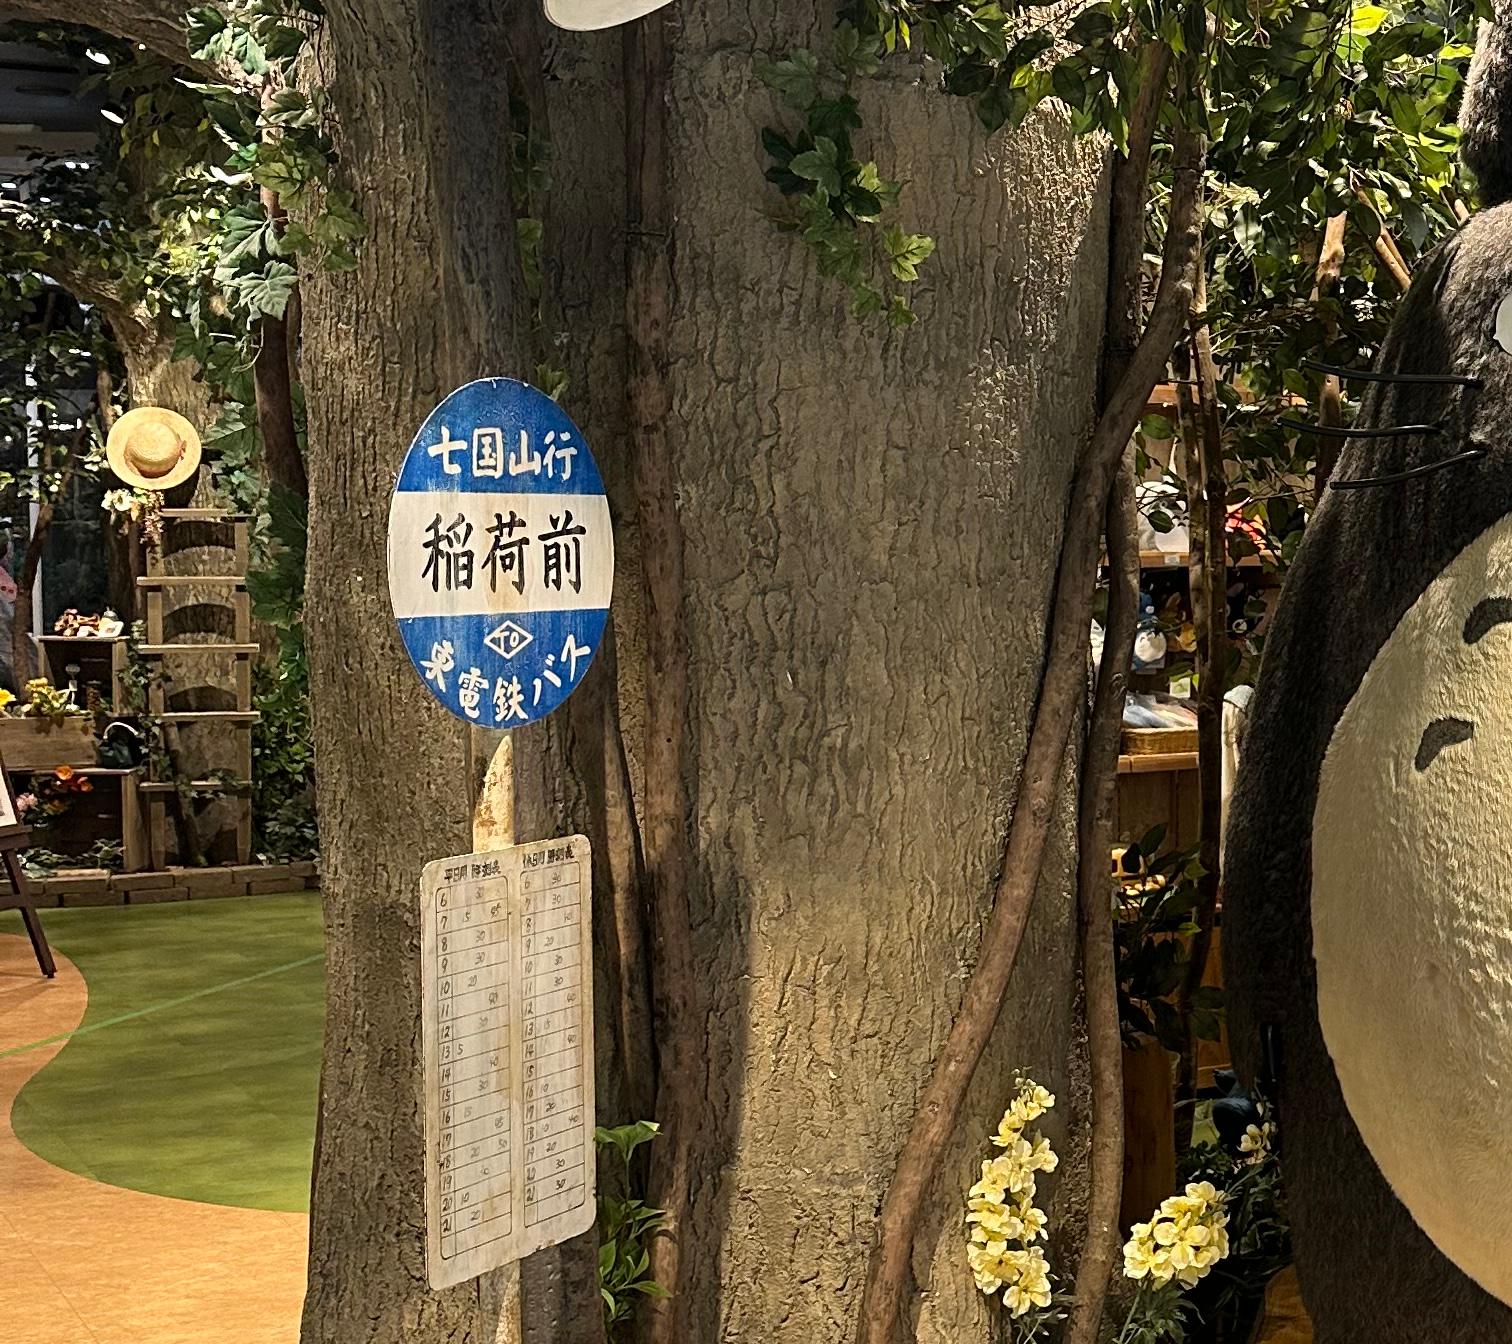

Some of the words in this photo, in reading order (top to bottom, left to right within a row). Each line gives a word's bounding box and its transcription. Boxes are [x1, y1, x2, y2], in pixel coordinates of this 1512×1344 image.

[427, 424, 578, 481] 七国山行
[421, 509, 587, 596] 稲荷前
[419, 634, 592, 722] 東電鉄バス
[442, 937, 448, 952] 8
[442, 957, 448, 973] 9
[440, 980, 450, 996] 10
[441, 1004, 450, 1017] 11
[525, 1001, 534, 1016] 12
[441, 1025, 450, 1039] 12
[525, 1021, 534, 1037] 13
[441, 1045, 451, 1061] 13
[442, 1067, 451, 1083] 14
[442, 1088, 451, 1103] 15
[442, 1110, 451, 1125] 16
[442, 1197, 453, 1212] 20
